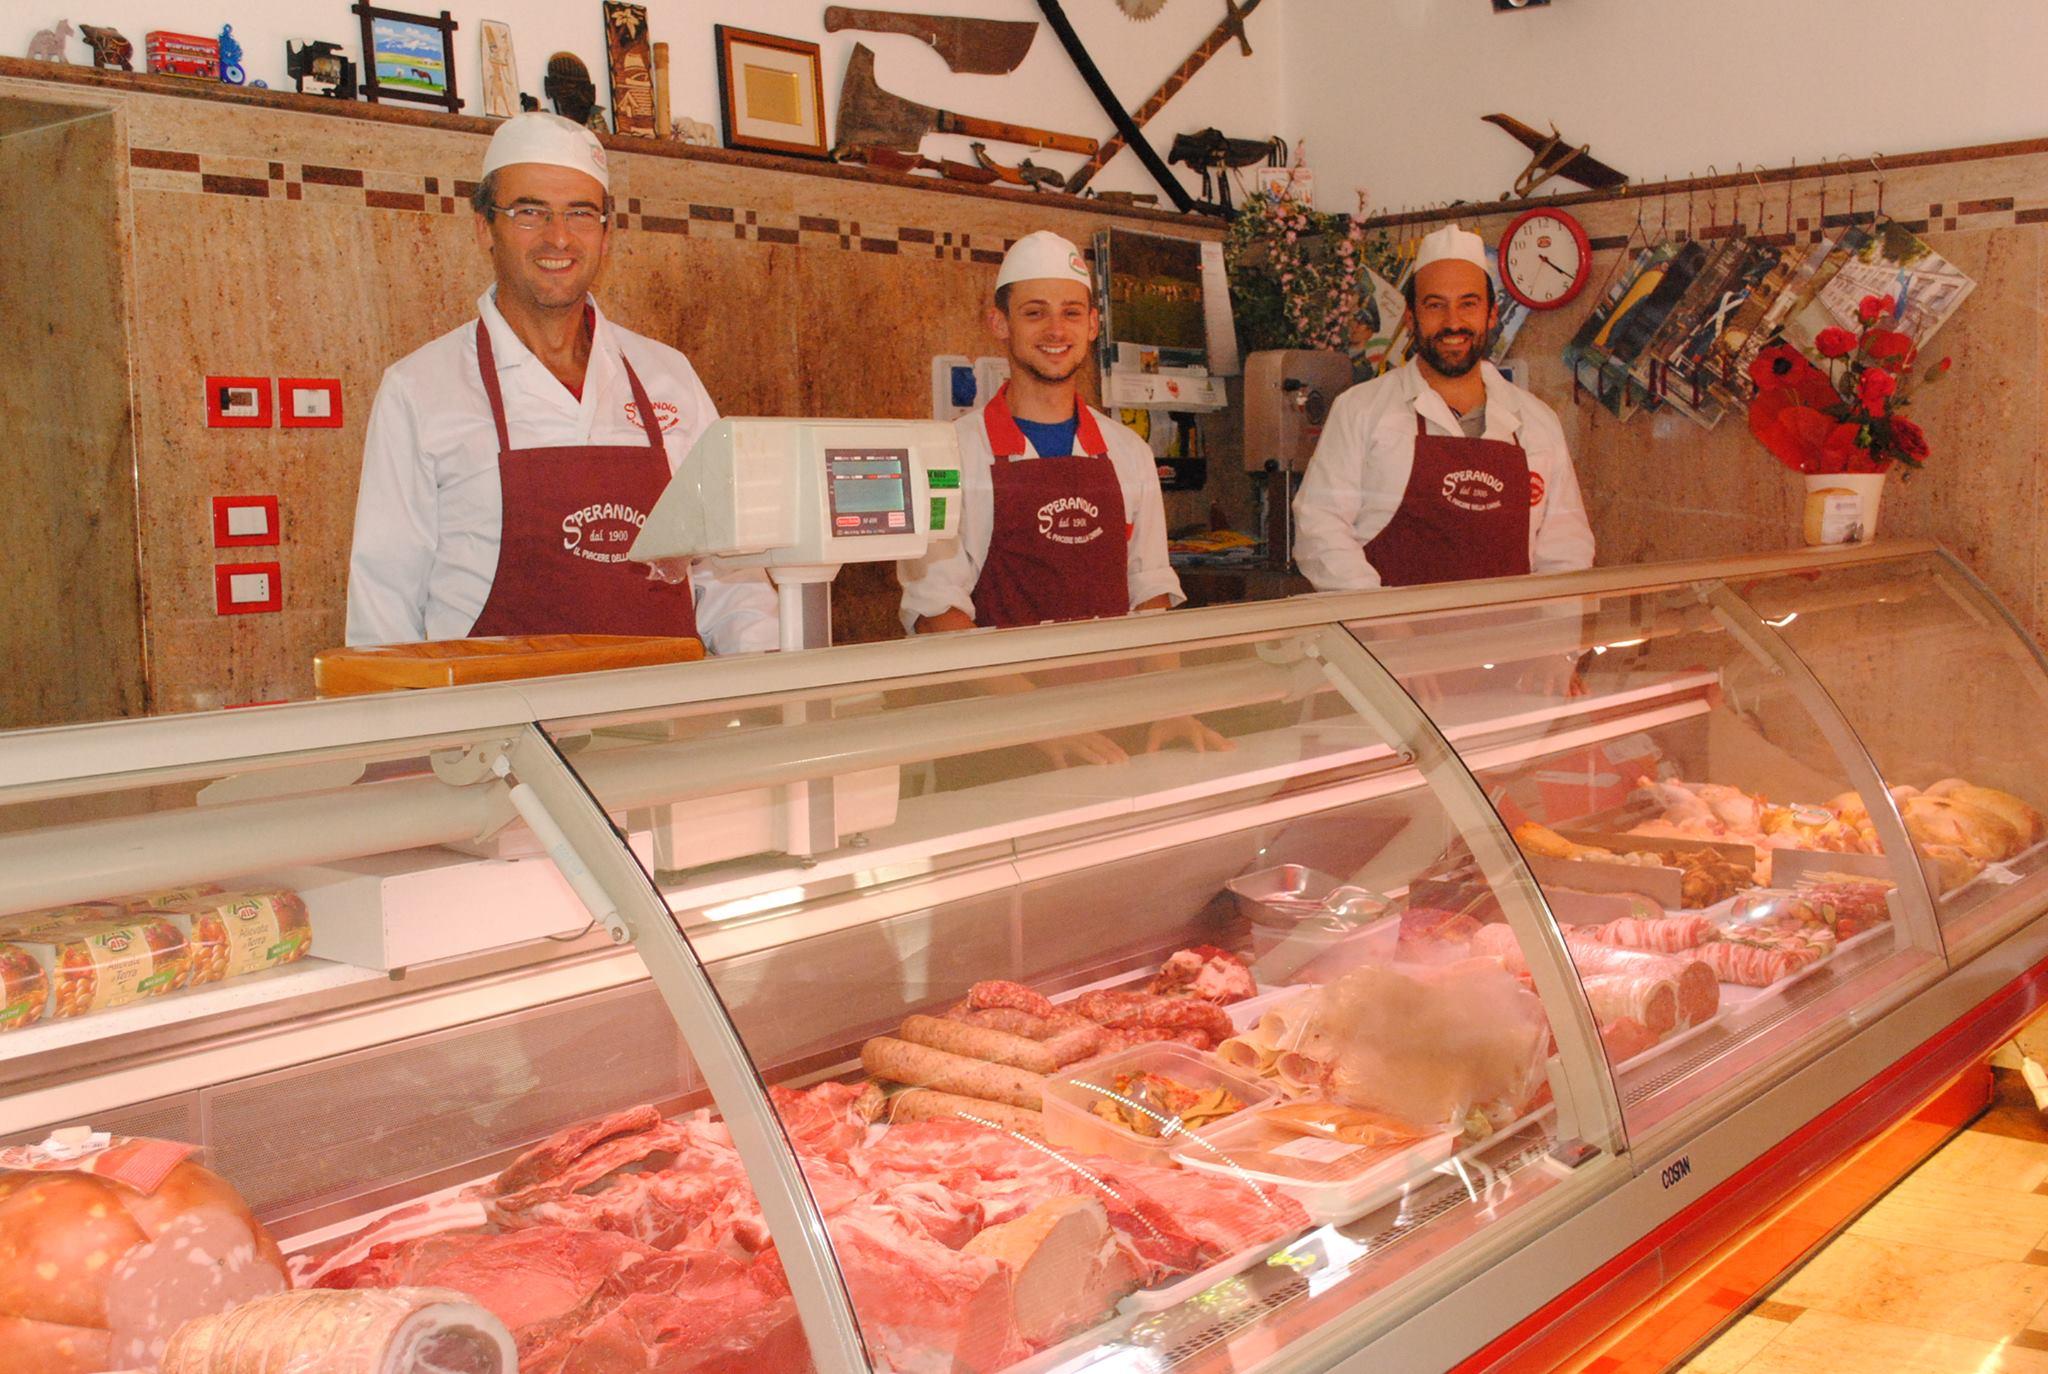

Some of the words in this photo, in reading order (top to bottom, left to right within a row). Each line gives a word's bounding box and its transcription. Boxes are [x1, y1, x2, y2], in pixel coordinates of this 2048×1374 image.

[1538, 217, 1550, 229] 12
[1523, 225, 1533, 236] 11
[1514, 240, 1526, 251] 10
[1510, 258, 1518, 266] 9
[1545, 292, 1553, 300] 6
[1442, 469, 1505, 496] SPERANDIO
[1037, 496, 1099, 534] SPERANDIO
[562, 502, 647, 551] SPERANDIO
[589, 529, 604, 543] dal
[609, 530, 629, 543] 1900
[572, 546, 581, 557] IL
[581, 549, 611, 564] PIACERE
